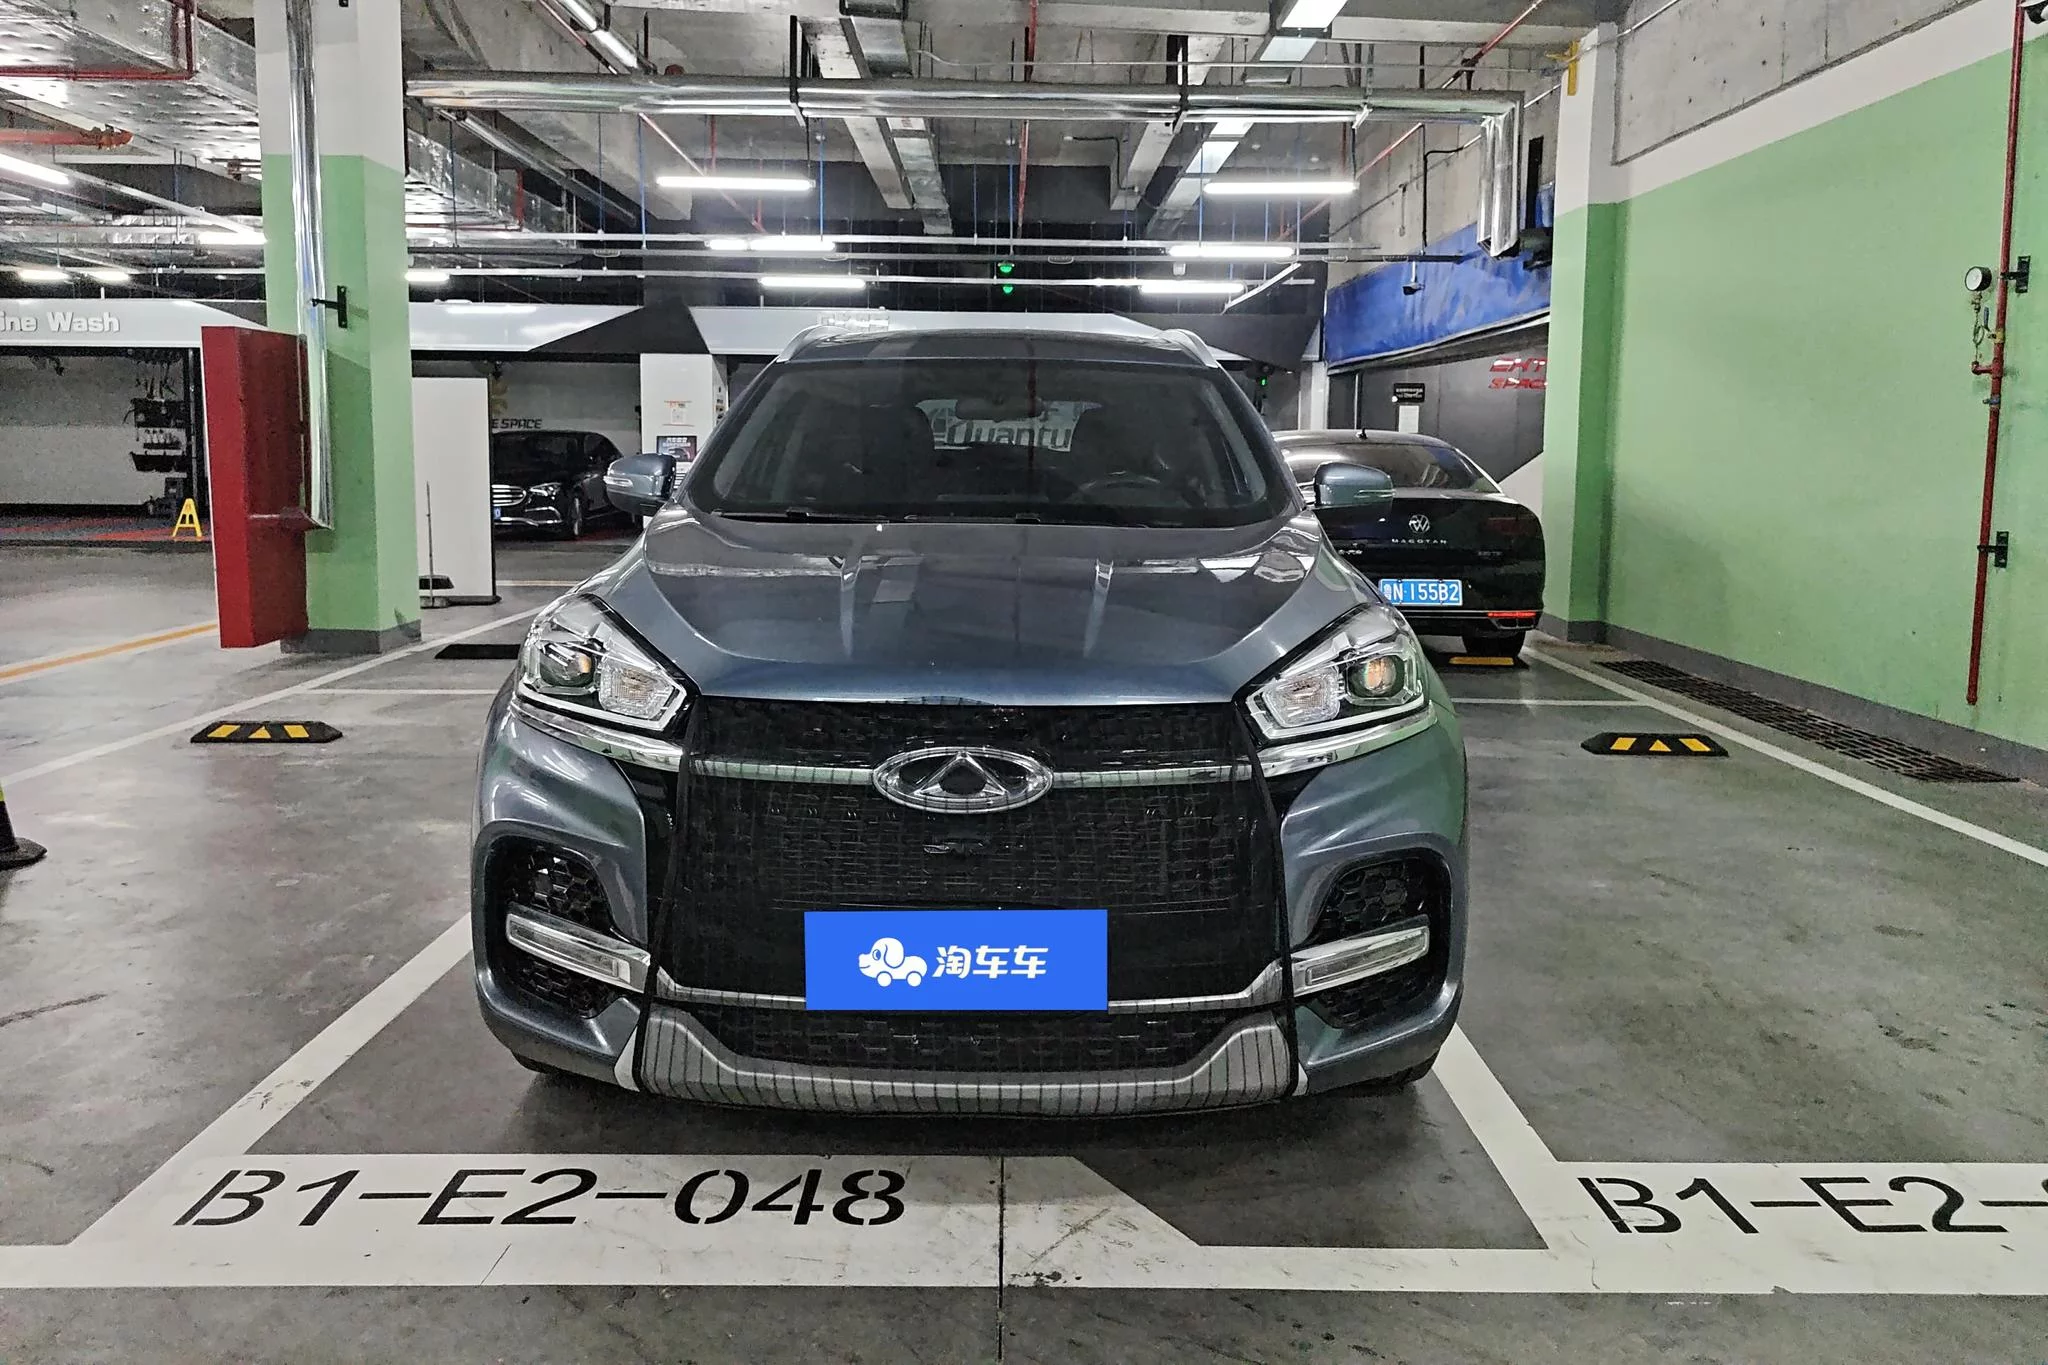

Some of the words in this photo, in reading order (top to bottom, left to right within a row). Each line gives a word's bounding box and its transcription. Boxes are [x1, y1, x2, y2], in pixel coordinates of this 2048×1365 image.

[47, 311, 120, 332] Wash
[501, 418, 543, 429] SPACE
[172, 1167, 907, 1227] B1-E2-048
[1576, 1174, 2048, 1234] B1-E2-
